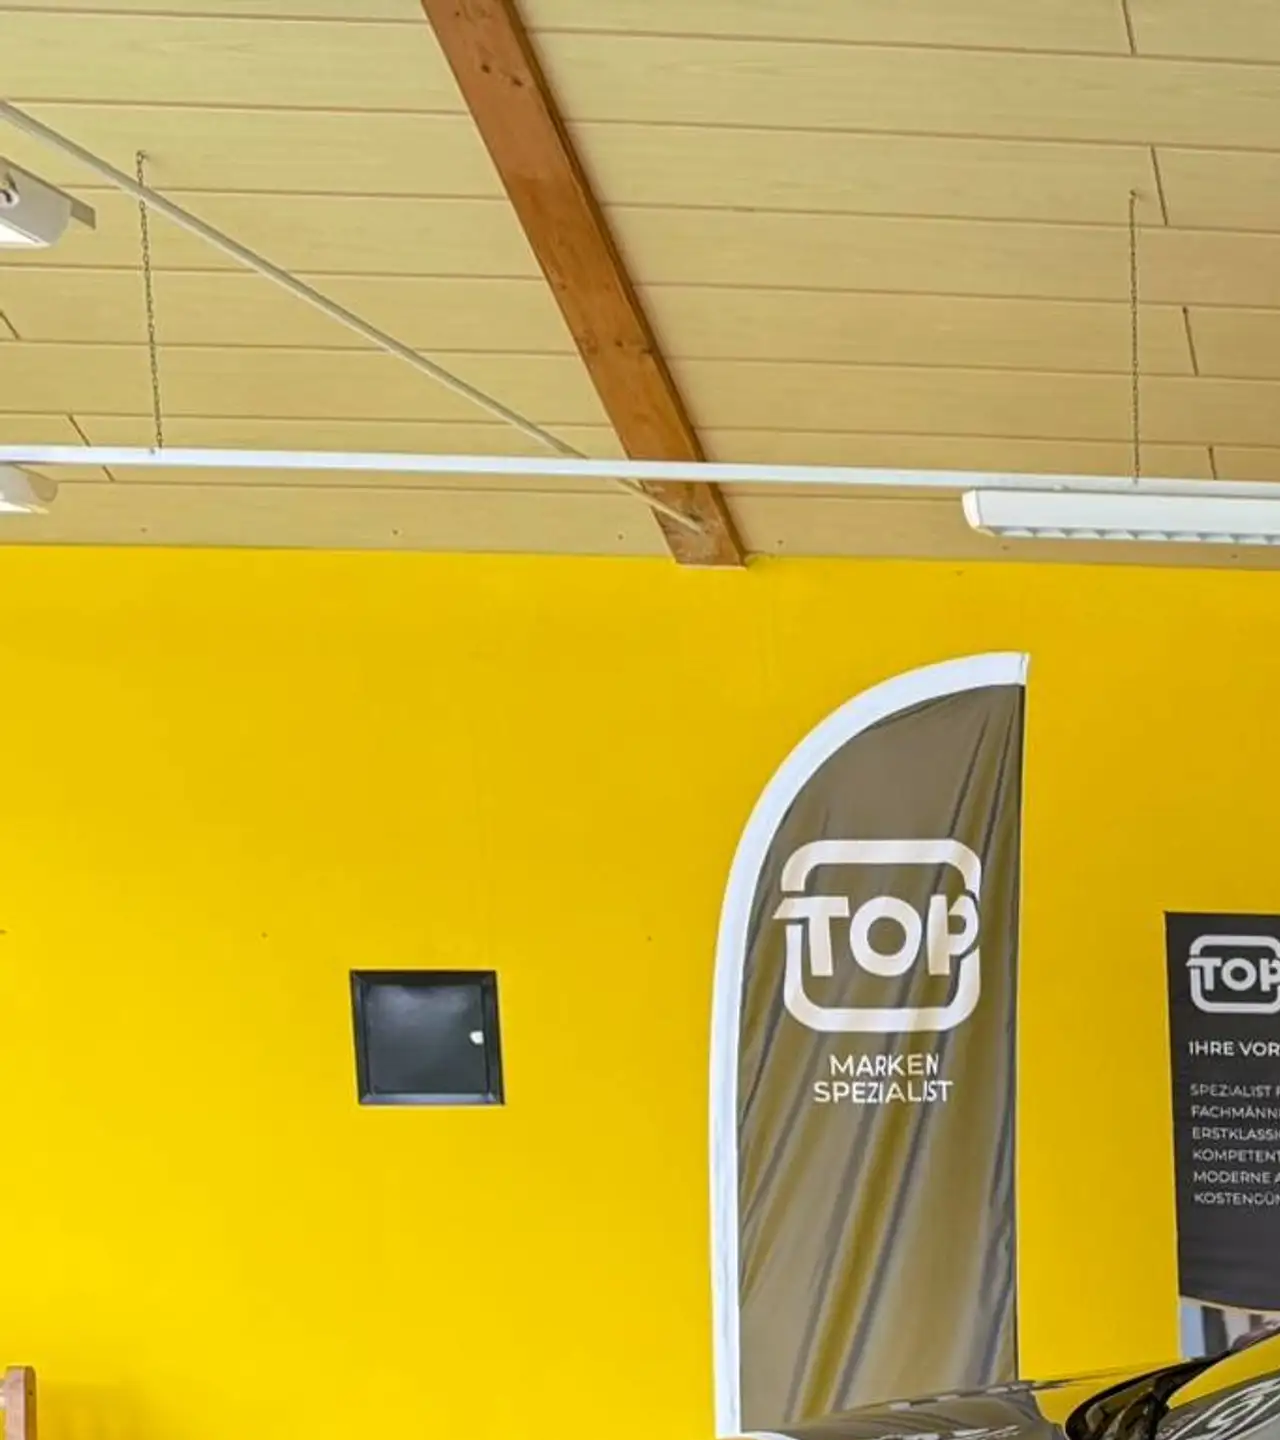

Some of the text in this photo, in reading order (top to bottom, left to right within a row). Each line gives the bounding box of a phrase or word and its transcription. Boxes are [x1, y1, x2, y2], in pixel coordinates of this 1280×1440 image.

[772, 893, 980, 977] TOP
[1188, 1041, 1234, 1057] IHRE
[829, 1053, 939, 1077] MARKEN
[813, 1081, 953, 1104] SPEZIALIST
[1190, 1084, 1271, 1098] SPEZIALIST
[1194, 1171, 1271, 1184] MODERNE
